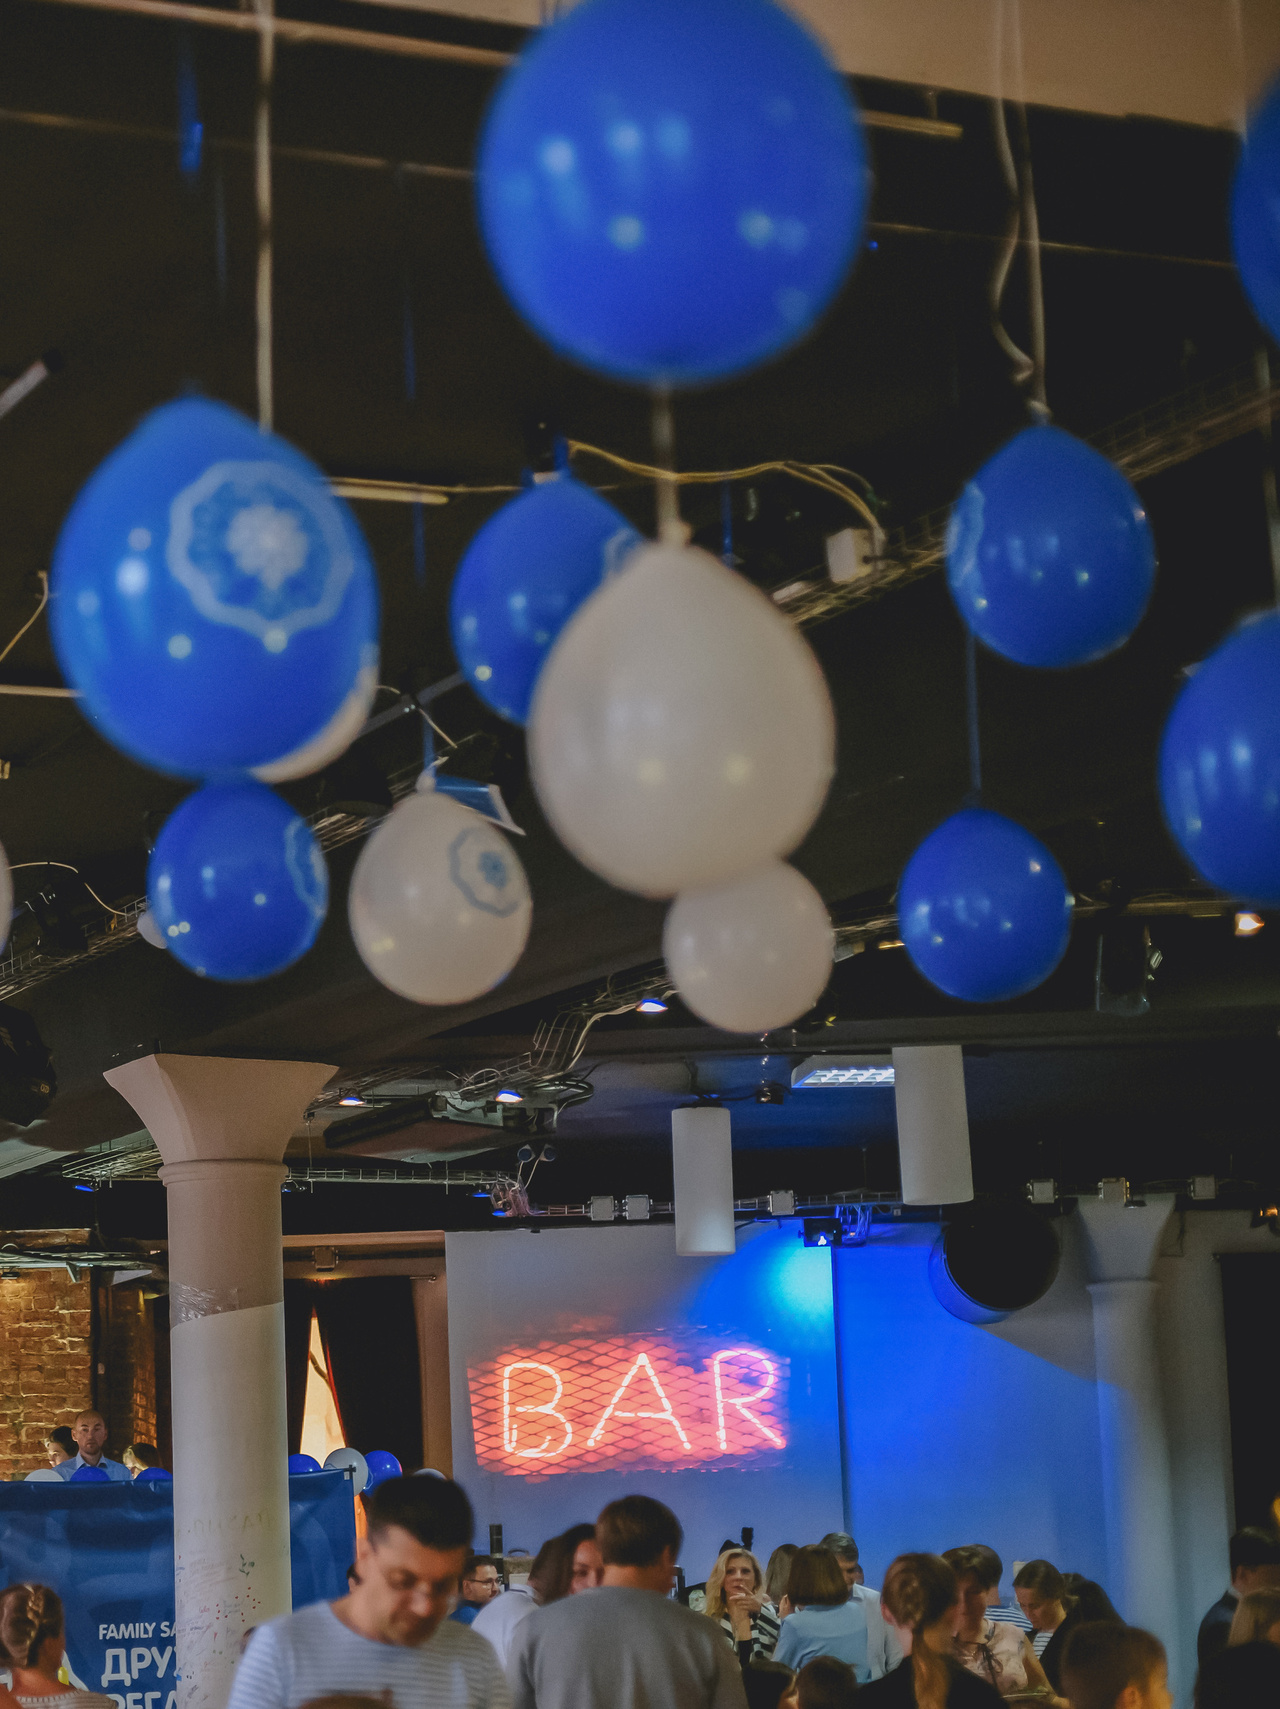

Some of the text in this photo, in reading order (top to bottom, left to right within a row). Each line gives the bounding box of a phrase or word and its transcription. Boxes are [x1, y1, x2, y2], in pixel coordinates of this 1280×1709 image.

[501, 1349, 786, 1458] BAR
[98, 1622, 156, 1640] FAMILY
[100, 1645, 177, 1688] ДРУ
